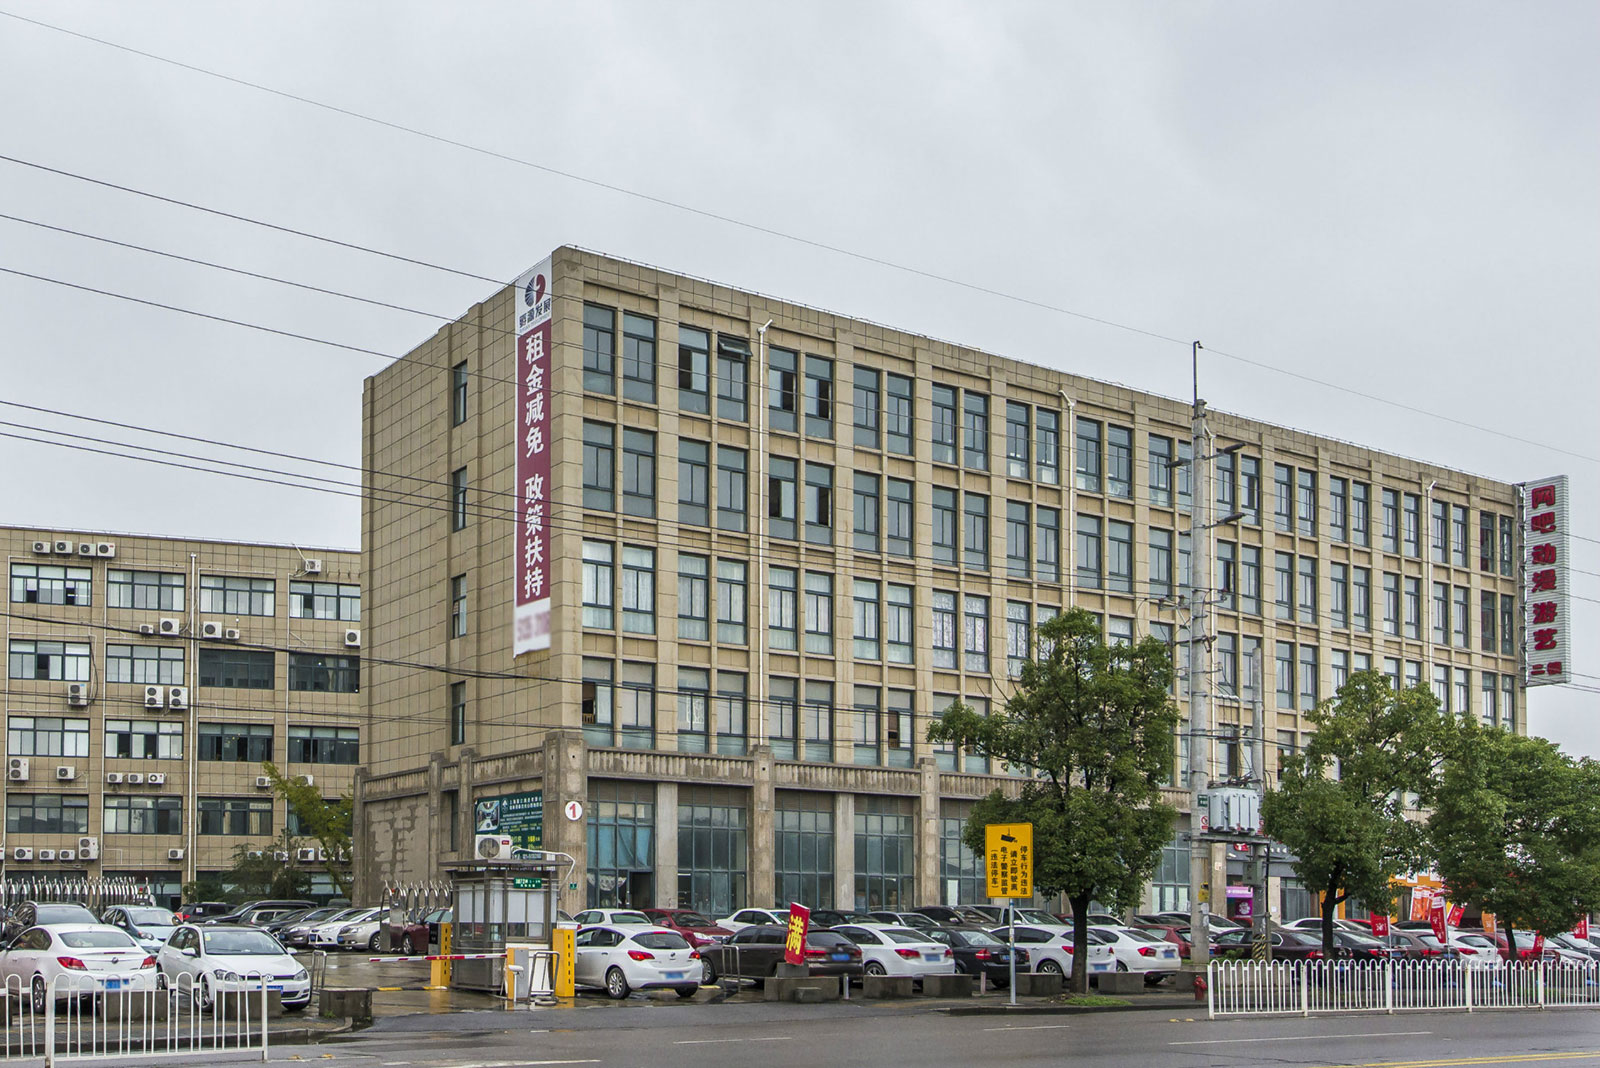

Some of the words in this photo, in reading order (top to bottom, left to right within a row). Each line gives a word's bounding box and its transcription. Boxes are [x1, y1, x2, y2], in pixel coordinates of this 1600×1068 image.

[525, 330, 544, 458] 租金减免
[524, 473, 544, 599] 政策扶持
[1531, 485, 1557, 651] 网吧动漫游艺
[1000, 846, 1008, 895] 电子警察监管
[1010, 850, 1018, 891] 请立即驶离
[1020, 846, 1028, 895] 停车行为违法
[786, 914, 805, 955] 满
